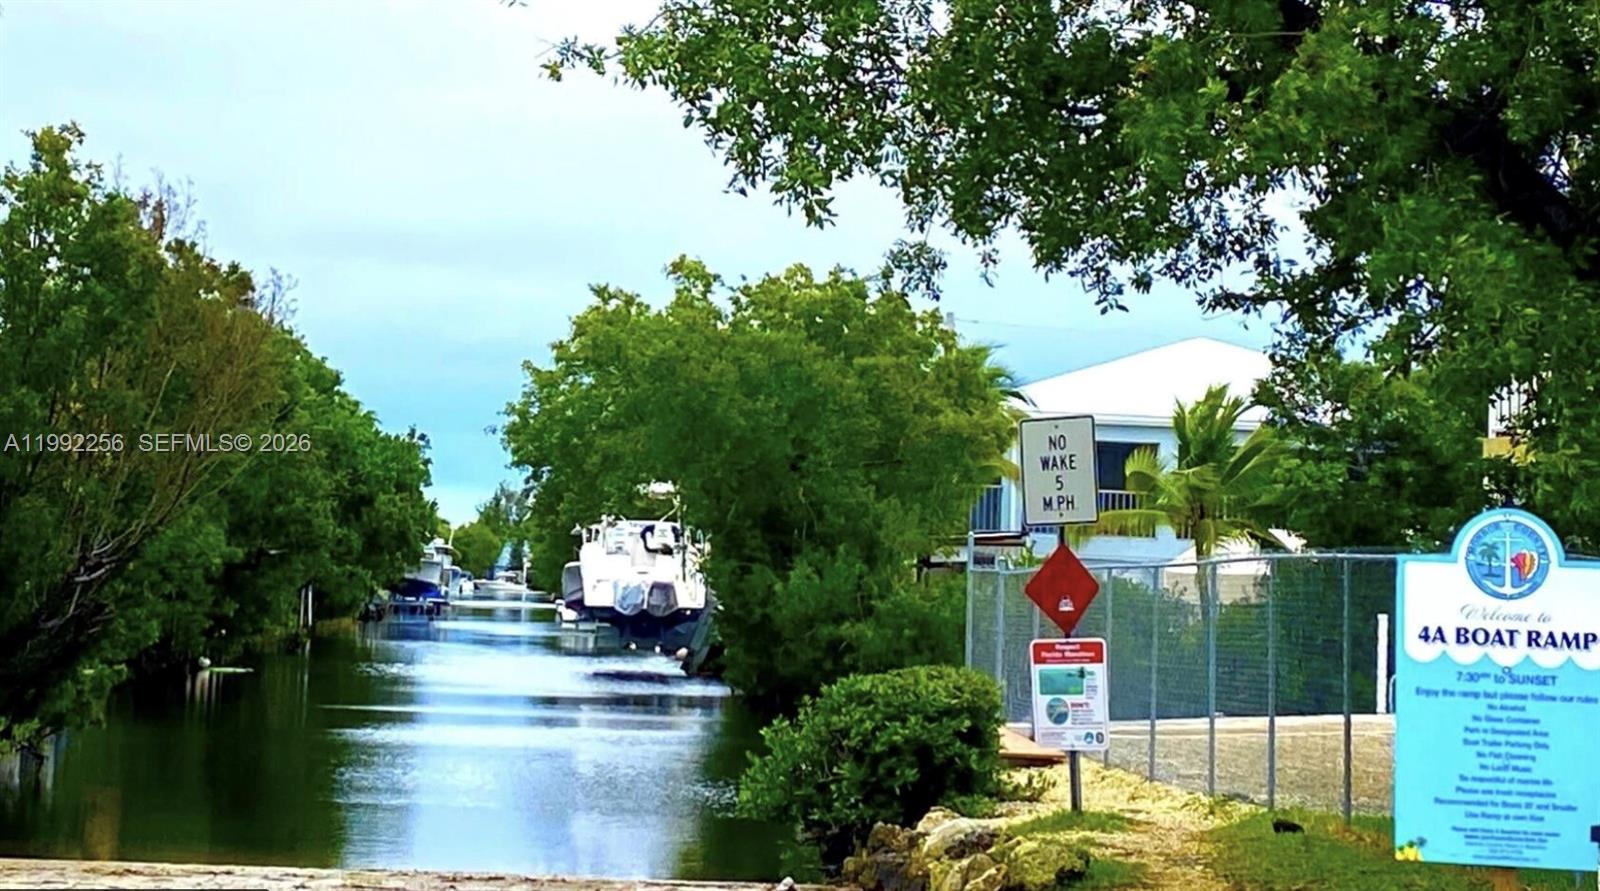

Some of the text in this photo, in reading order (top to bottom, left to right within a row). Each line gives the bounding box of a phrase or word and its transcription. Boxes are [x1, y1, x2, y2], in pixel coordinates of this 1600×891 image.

[1048, 434, 1067, 451] NO
[1040, 454, 1077, 471] WAKE
[1055, 475, 1064, 491] 5
[1460, 604, 1552, 623] Welcome to
[1418, 626, 1598, 650] 4A BOAT RAMP
[1494, 673, 1505, 684] to
[1508, 674, 1557, 686] SUNSET
[1416, 687, 1599, 704] Enjoy the ramp but please follow our rules
